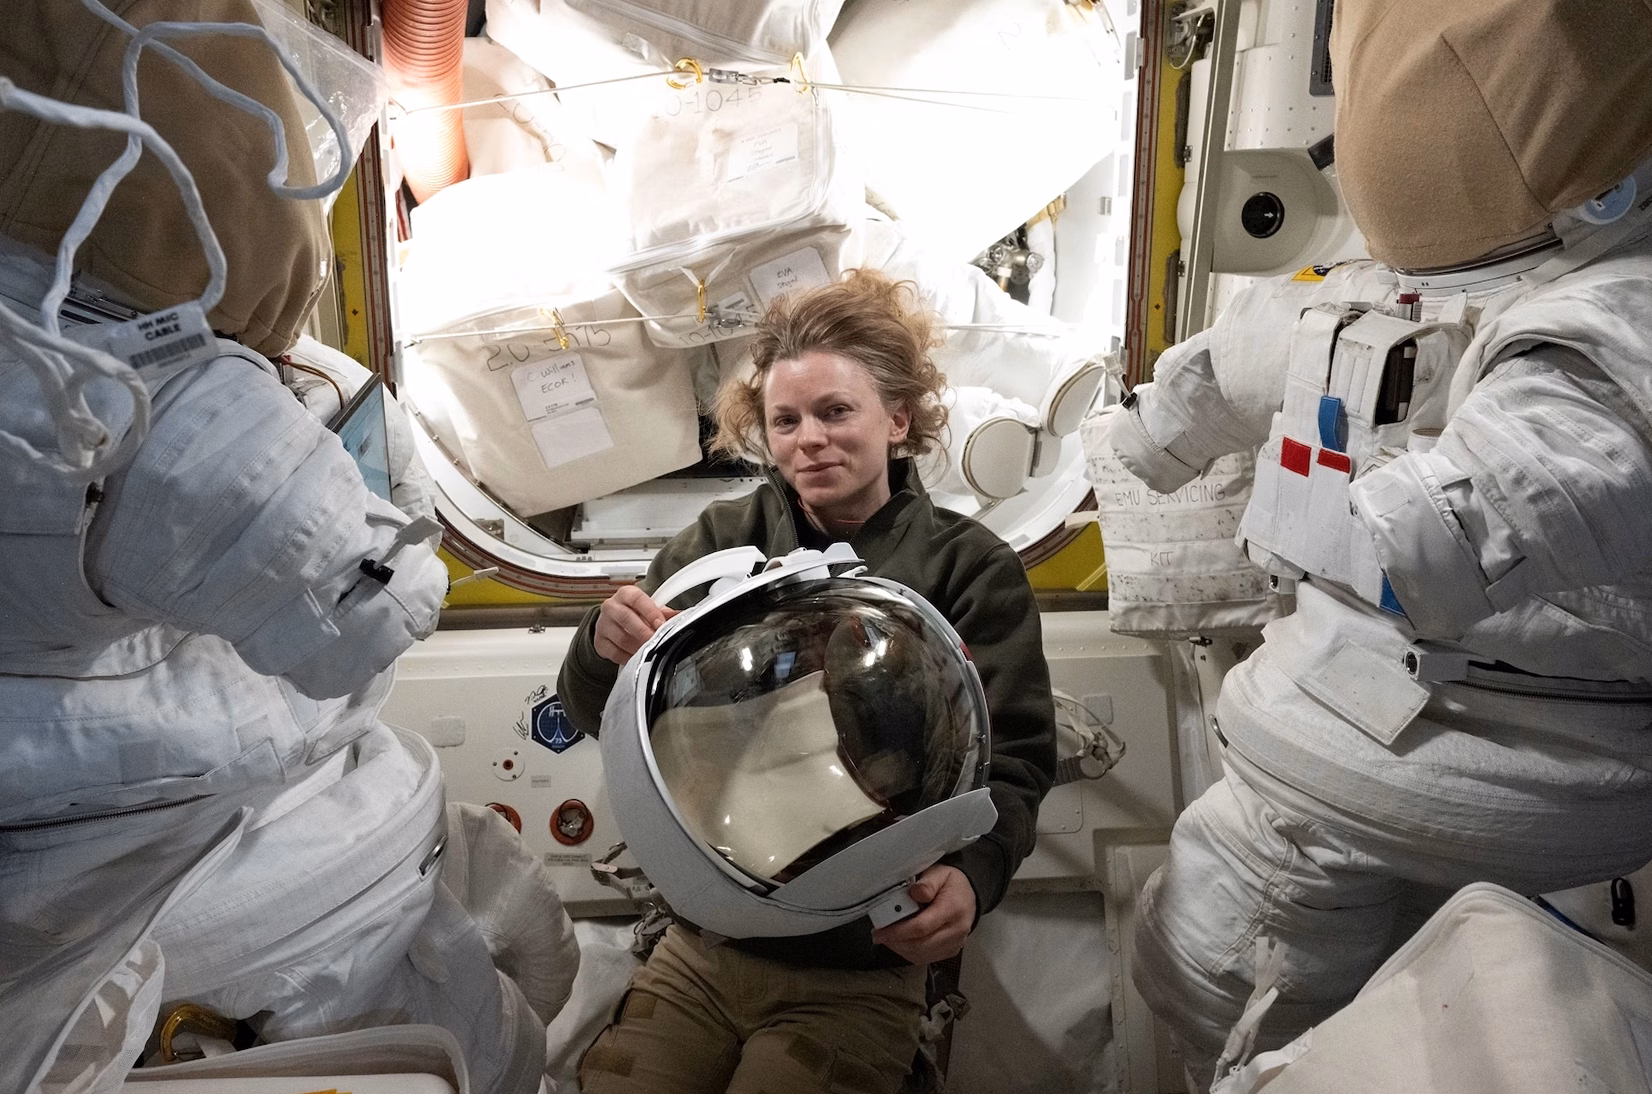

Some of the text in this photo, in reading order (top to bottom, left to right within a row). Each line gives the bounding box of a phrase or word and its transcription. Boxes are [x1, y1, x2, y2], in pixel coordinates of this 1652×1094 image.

[776, 267, 794, 279] EVA
[137, 312, 179, 331] HH MIC
[144, 323, 181, 341] CABLE
[1115, 483, 1226, 507] EMU SERVICING
[1150, 551, 1174, 566] KIT
